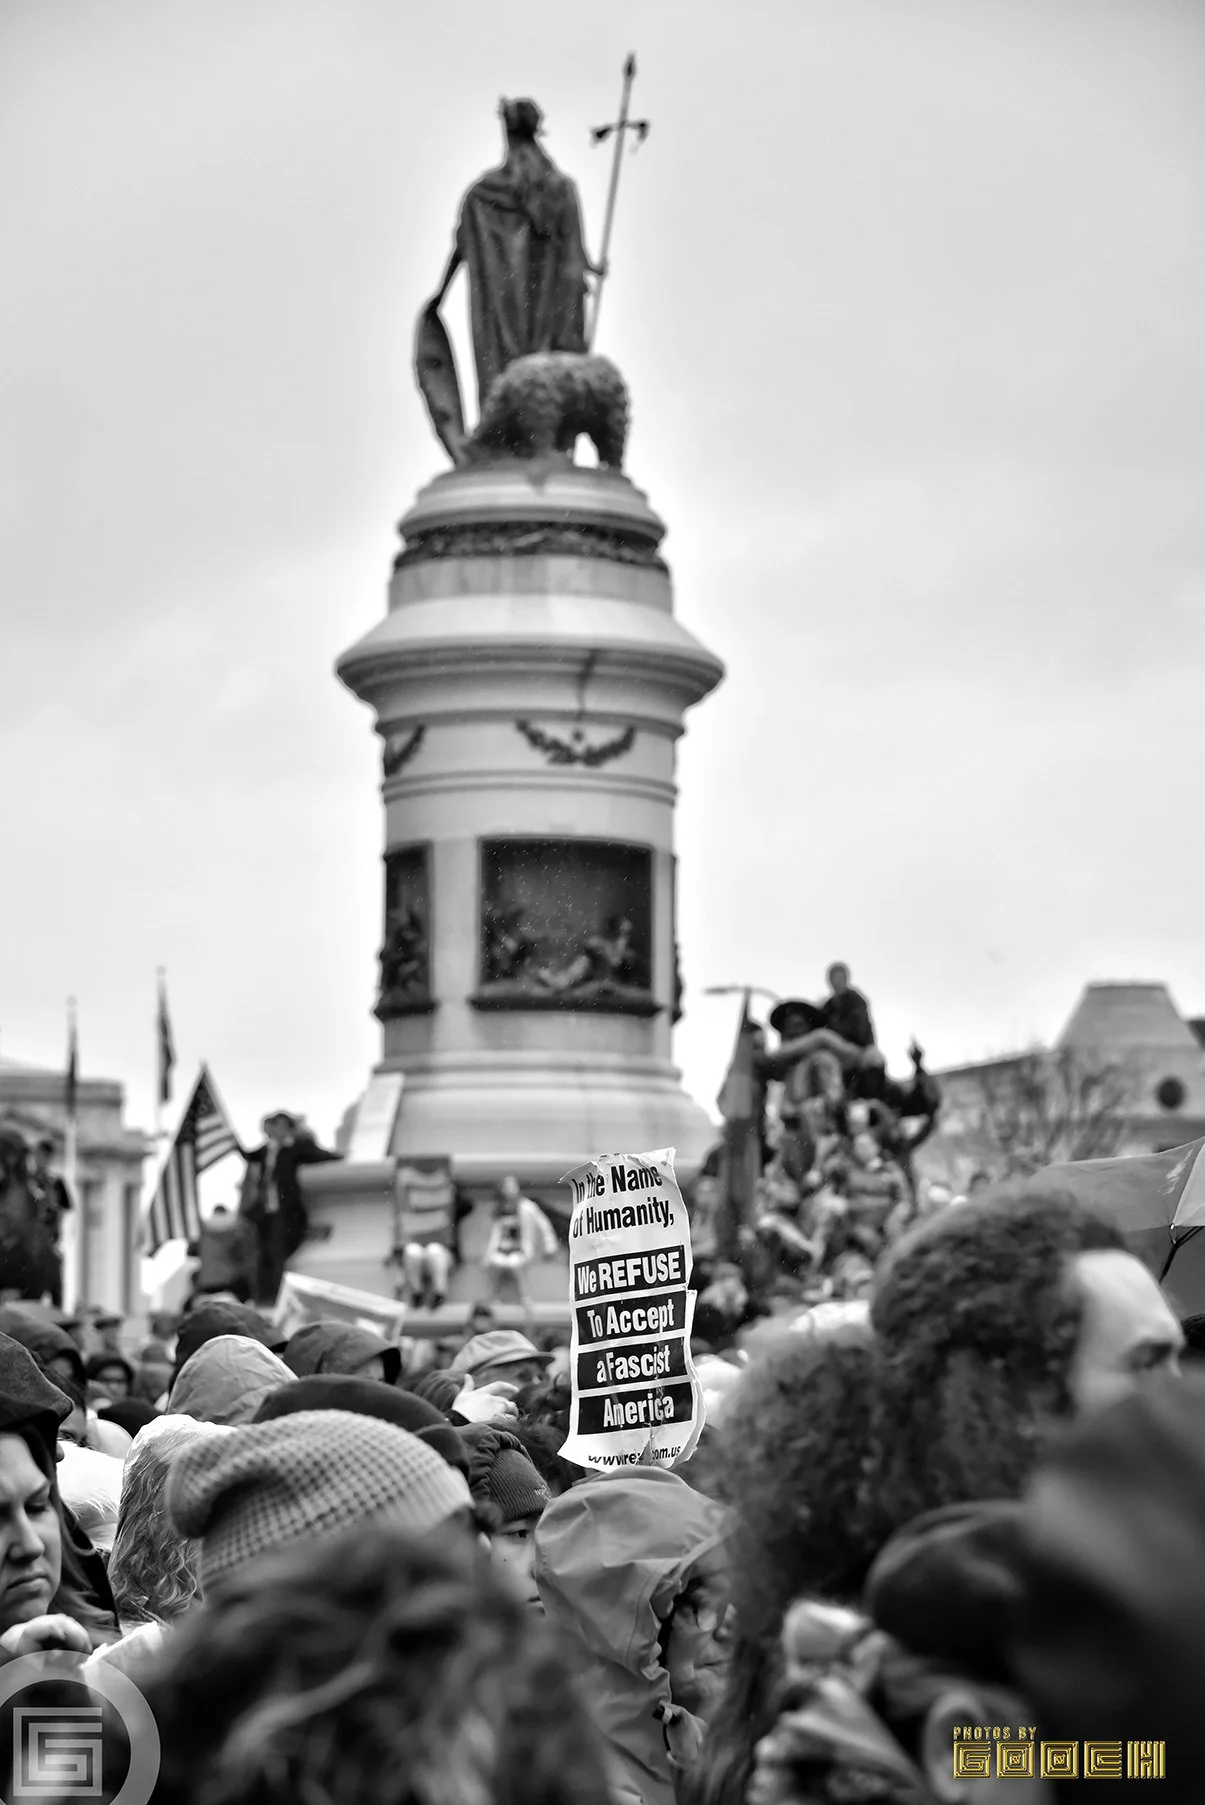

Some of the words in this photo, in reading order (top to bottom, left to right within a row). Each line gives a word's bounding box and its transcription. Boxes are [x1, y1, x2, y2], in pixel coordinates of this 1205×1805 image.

[572, 1179, 585, 1203] In
[586, 1172, 605, 1199] the
[611, 1165, 662, 1193] Name
[573, 1210, 583, 1238] of
[586, 1197, 674, 1235] Humanity,
[577, 1265, 597, 1295] We
[598, 1251, 681, 1290] REFUSE
[587, 1309, 603, 1338] To
[606, 1298, 675, 1335] Accept
[596, 1359, 607, 1383] a
[606, 1345, 670, 1380] Fascist
